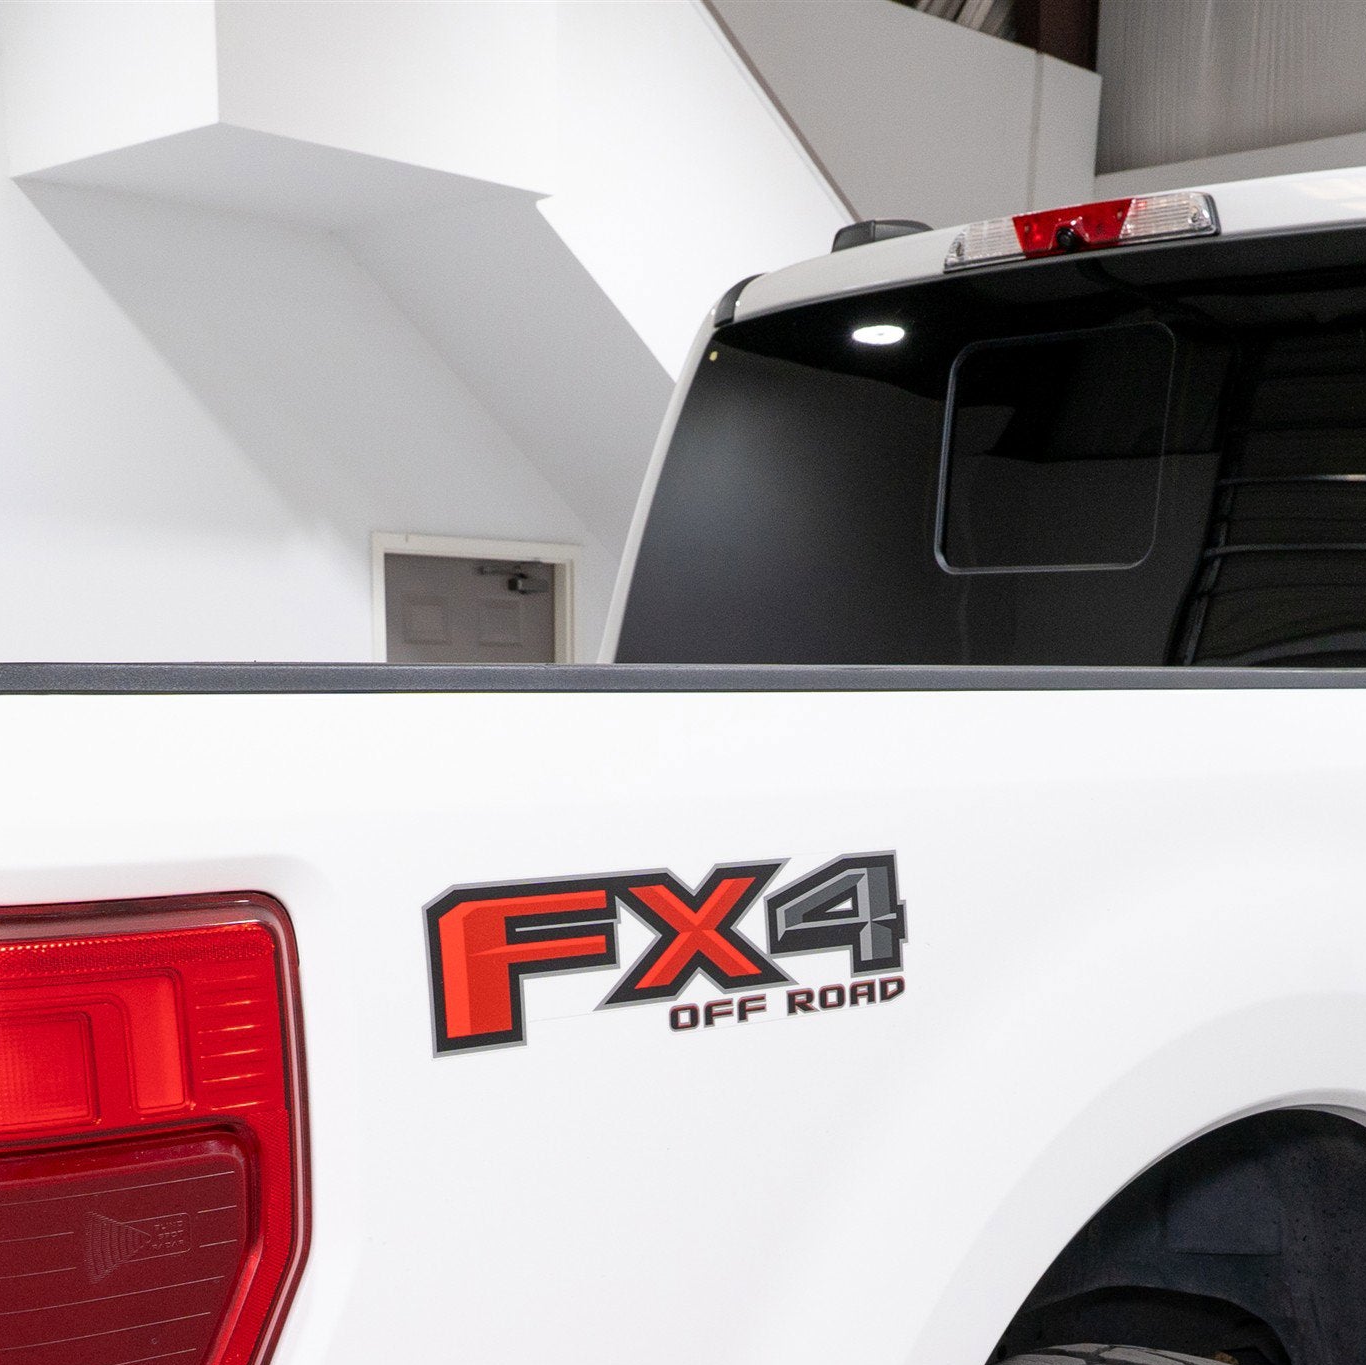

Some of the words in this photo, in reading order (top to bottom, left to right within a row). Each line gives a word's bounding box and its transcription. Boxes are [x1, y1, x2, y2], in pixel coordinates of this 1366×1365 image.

[421, 849, 908, 1058] FX4
[669, 993, 767, 1033] OFF
[786, 975, 906, 1016] ROAD
